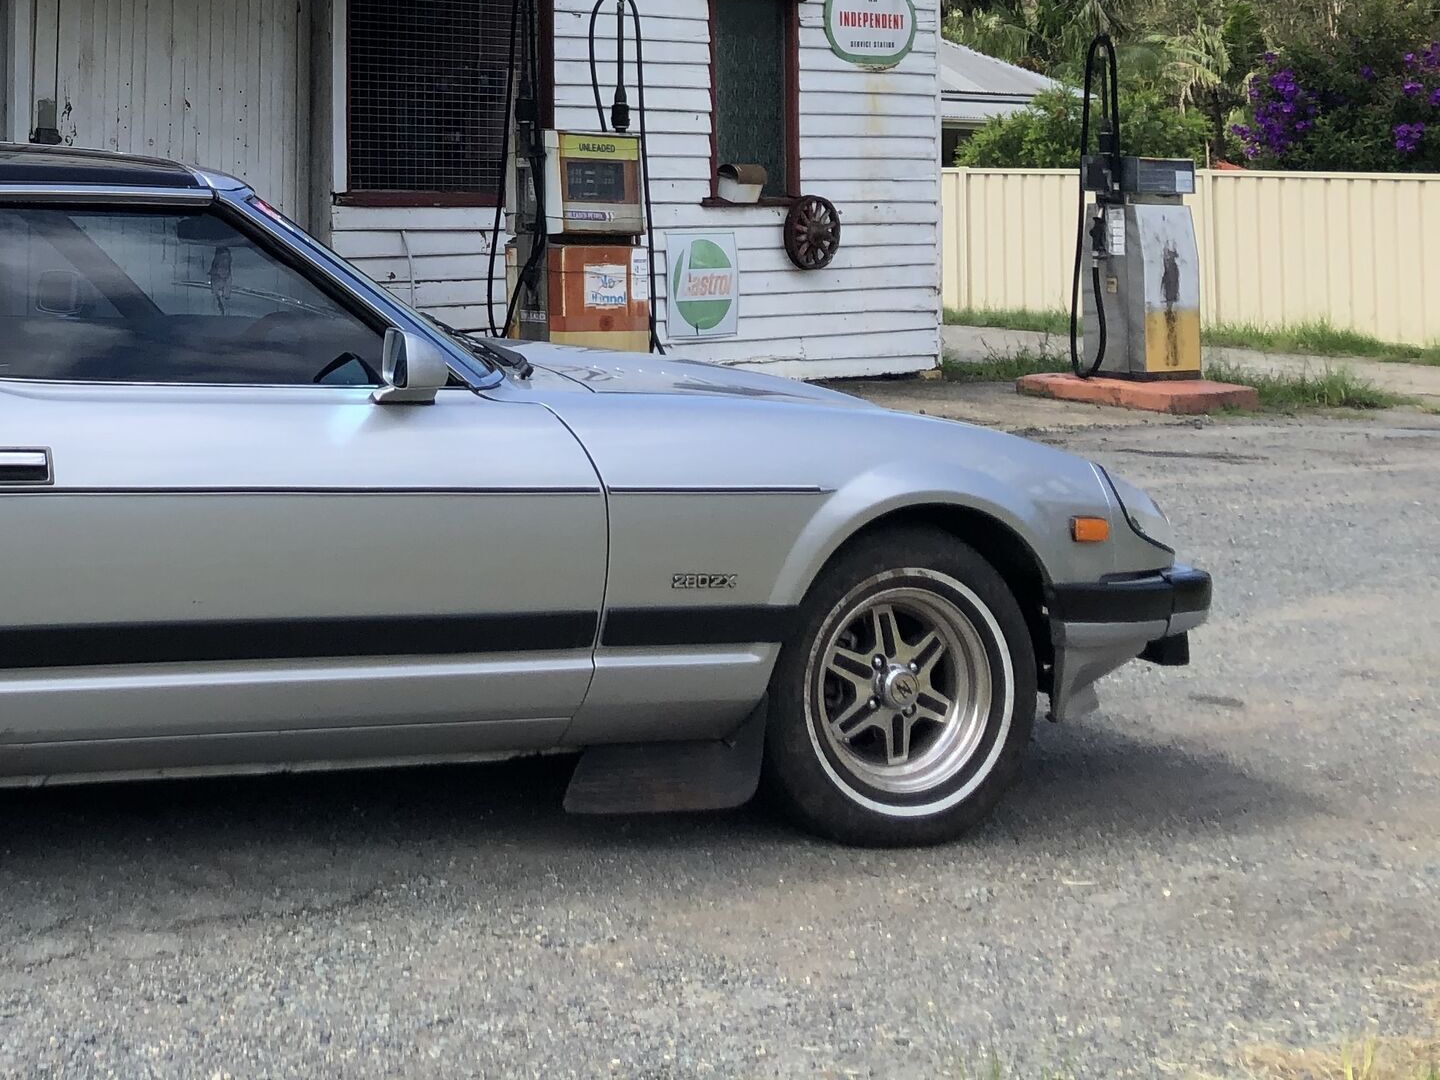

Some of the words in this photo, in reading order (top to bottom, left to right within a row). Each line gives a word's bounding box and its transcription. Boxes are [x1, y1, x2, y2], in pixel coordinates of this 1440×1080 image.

[839, 10, 905, 30] INDEPENDENT
[873, 40, 895, 49] STATION
[578, 143, 616, 153] UNLEADED
[671, 572, 738, 589] 280ZX
